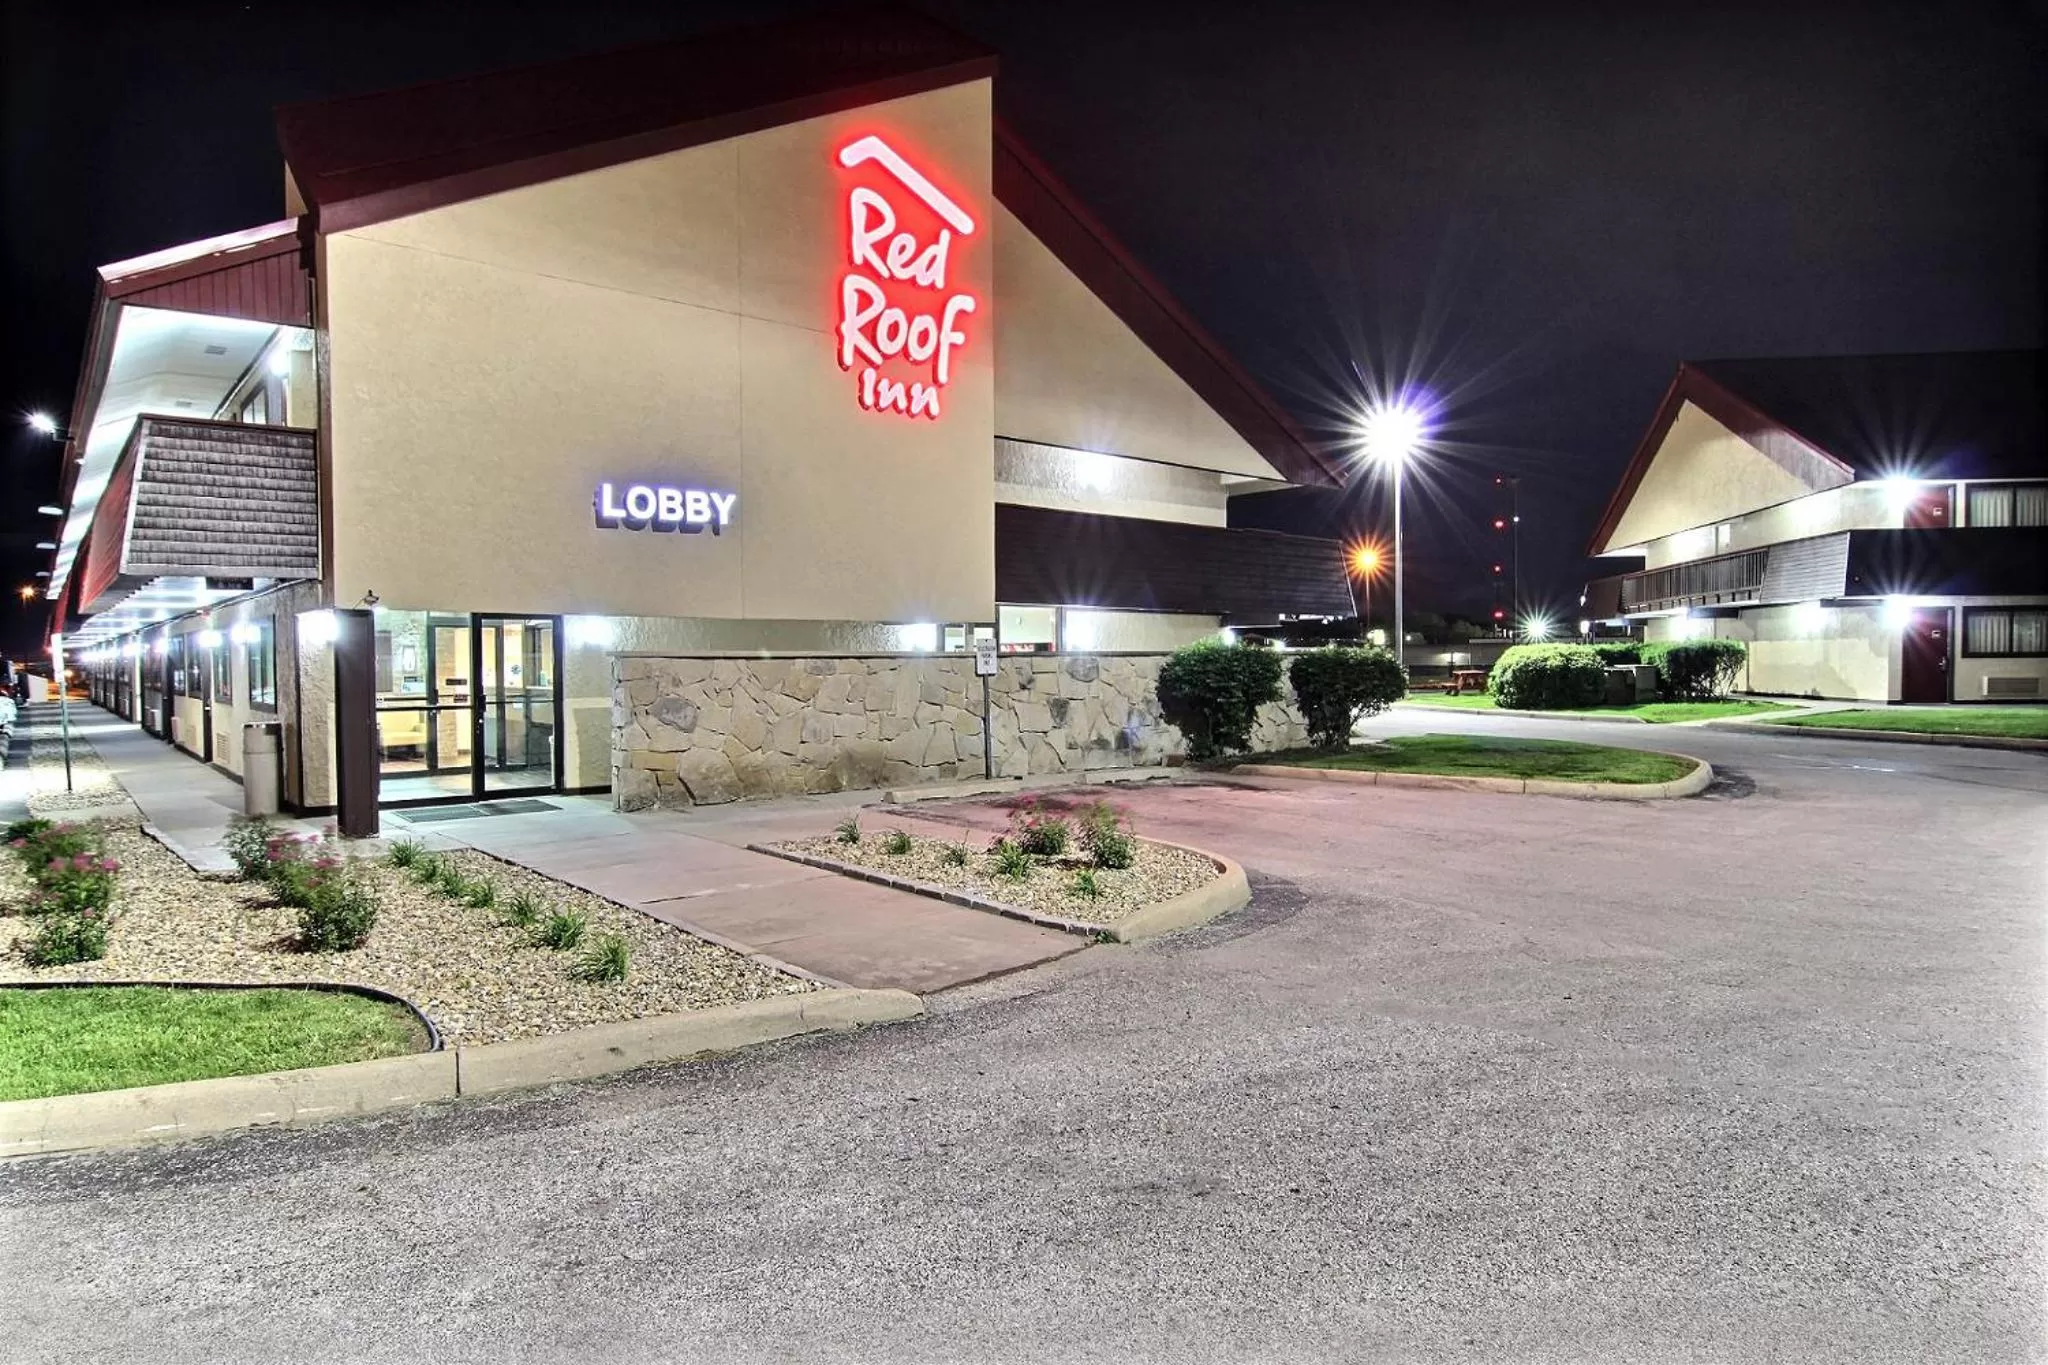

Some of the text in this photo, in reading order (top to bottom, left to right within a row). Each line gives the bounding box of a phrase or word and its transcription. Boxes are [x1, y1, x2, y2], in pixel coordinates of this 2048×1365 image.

[850, 186, 950, 290] Red
[838, 273, 977, 385] Roof
[597, 482, 737, 530] LOBBY
